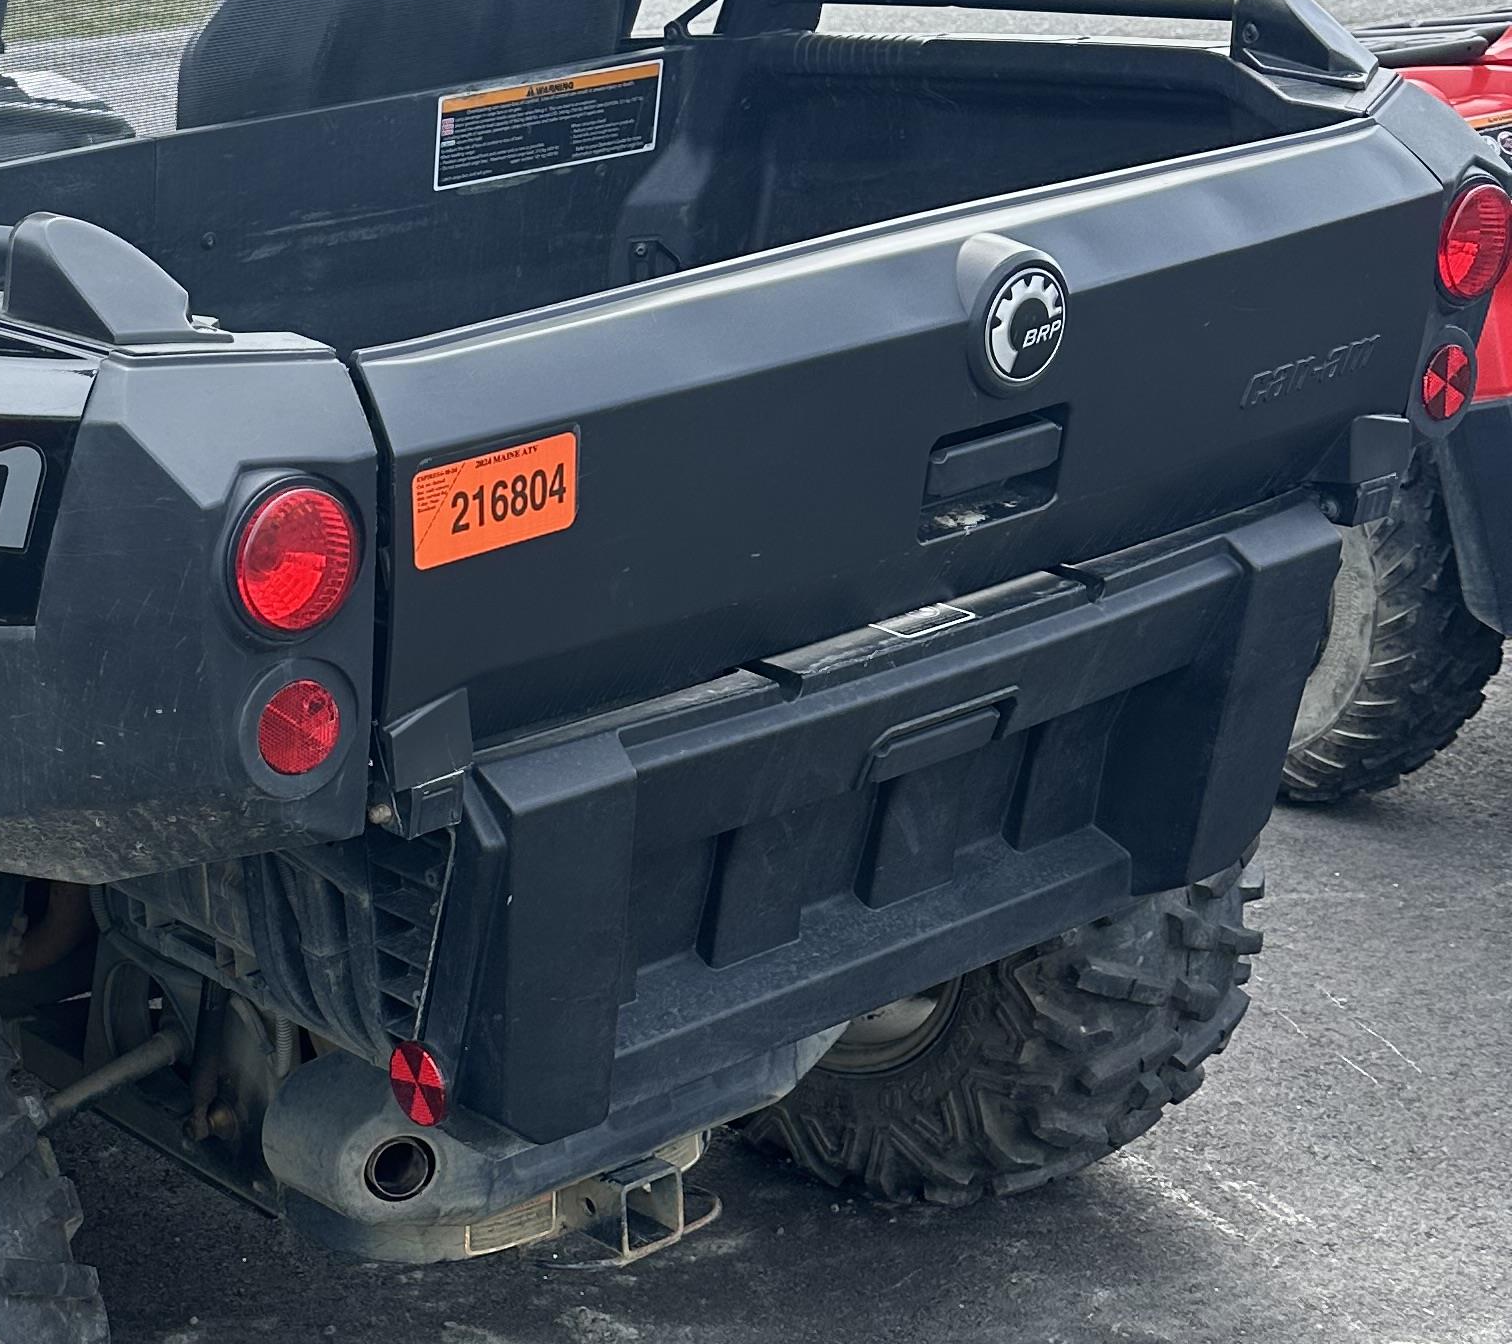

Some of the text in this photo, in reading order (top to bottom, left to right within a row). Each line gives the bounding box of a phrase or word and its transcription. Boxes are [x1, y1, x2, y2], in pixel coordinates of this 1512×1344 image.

[536, 81, 574, 95] WARNING
[1022, 319, 1062, 348] BRP
[1240, 333, 1381, 409] can-am
[493, 449, 521, 464] MAINE
[521, 445, 539, 458] ATV
[451, 462, 567, 535] 216804
